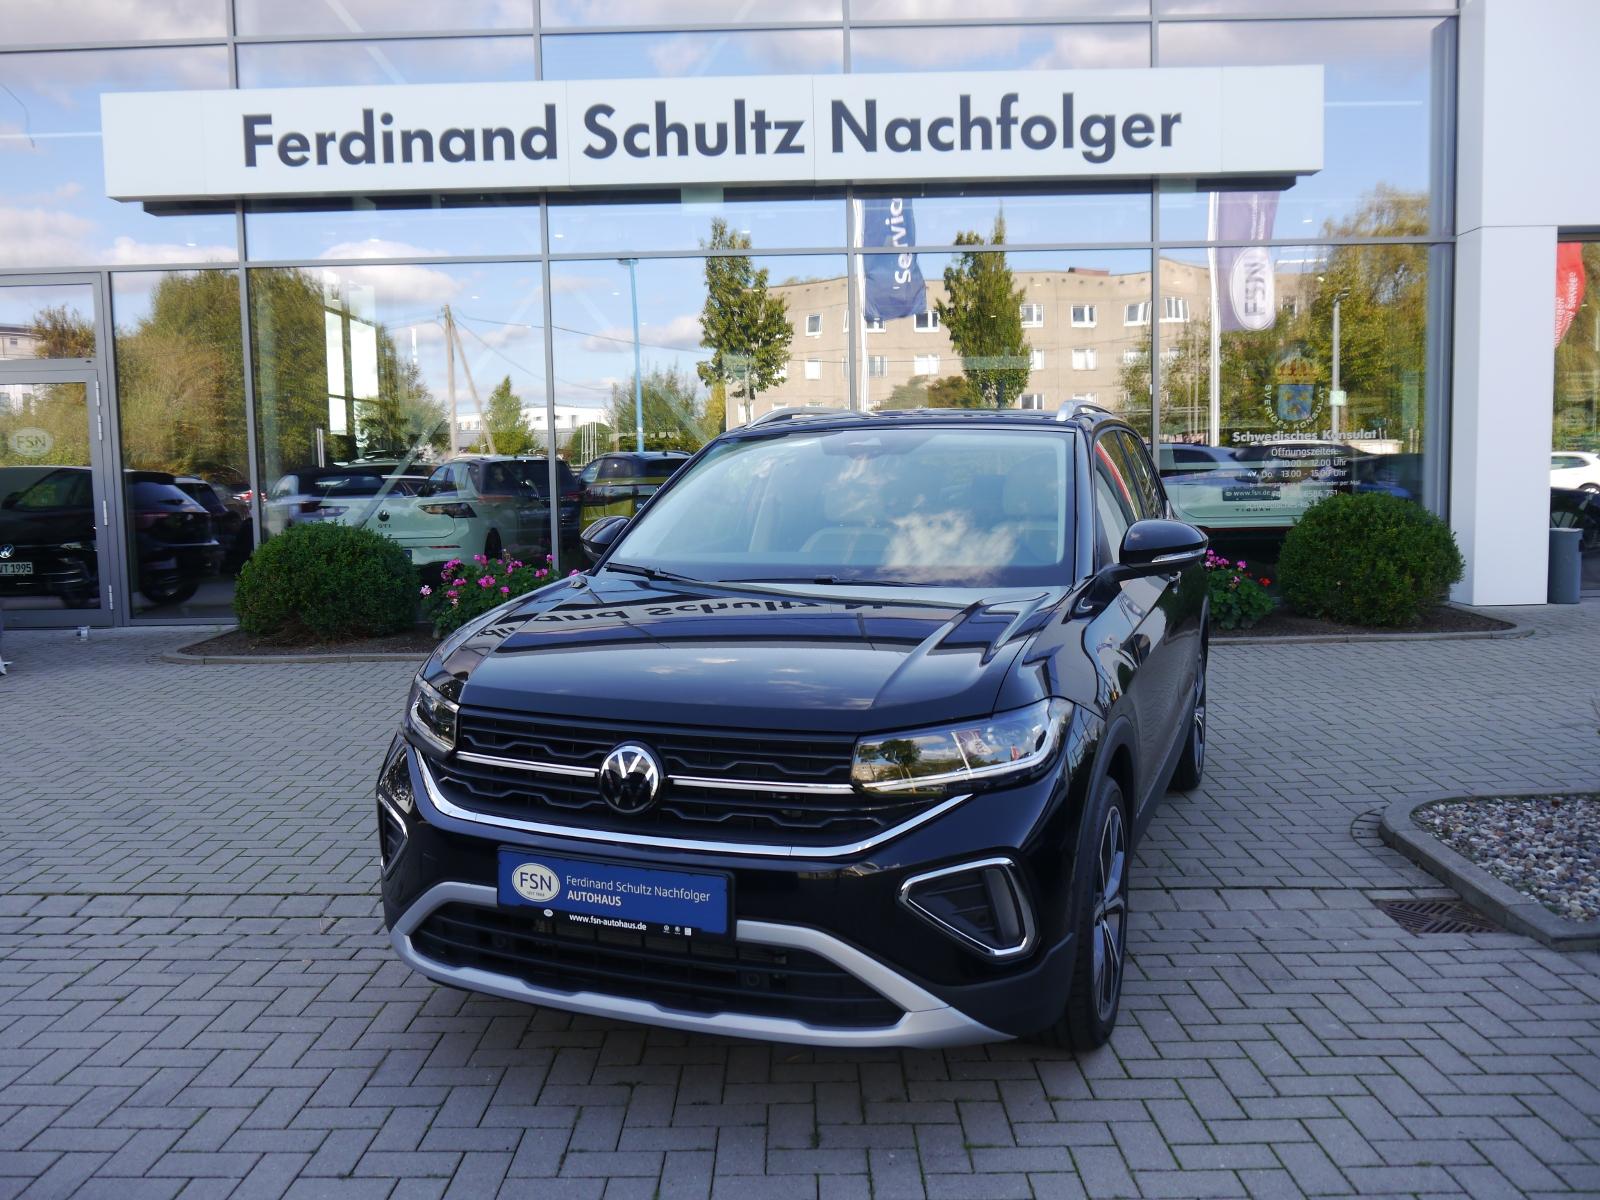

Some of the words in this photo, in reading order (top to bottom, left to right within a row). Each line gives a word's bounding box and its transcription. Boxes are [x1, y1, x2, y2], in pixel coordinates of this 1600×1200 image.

[243, 104, 558, 166] Ferdinand
[583, 99, 805, 160] Schultz
[831, 92, 1182, 164] Nachfolger
[1244, 262, 1266, 317] FSN
[1264, 384, 1289, 430] SVERIGES
[1293, 386, 1325, 430] KONSULAT
[15, 434, 47, 449] FSN
[1232, 430, 1318, 443] Schwedisches
[1322, 429, 1377, 441] Konsulat
[1333, 458, 1347, 467] Uhr
[1281, 470, 1301, 478] 13.00
[1333, 469, 1347, 477] Uhr
[10, 563, 32, 574] 1995
[519, 871, 553, 892] FSN
[566, 875, 614, 891] Ferdinand
[615, 881, 653, 896] Schultz
[653, 885, 712, 903] Nachfolger
[567, 889, 623, 907] AUTOHAUS
[568, 913, 648, 932] www.fsn-autohaus.de
